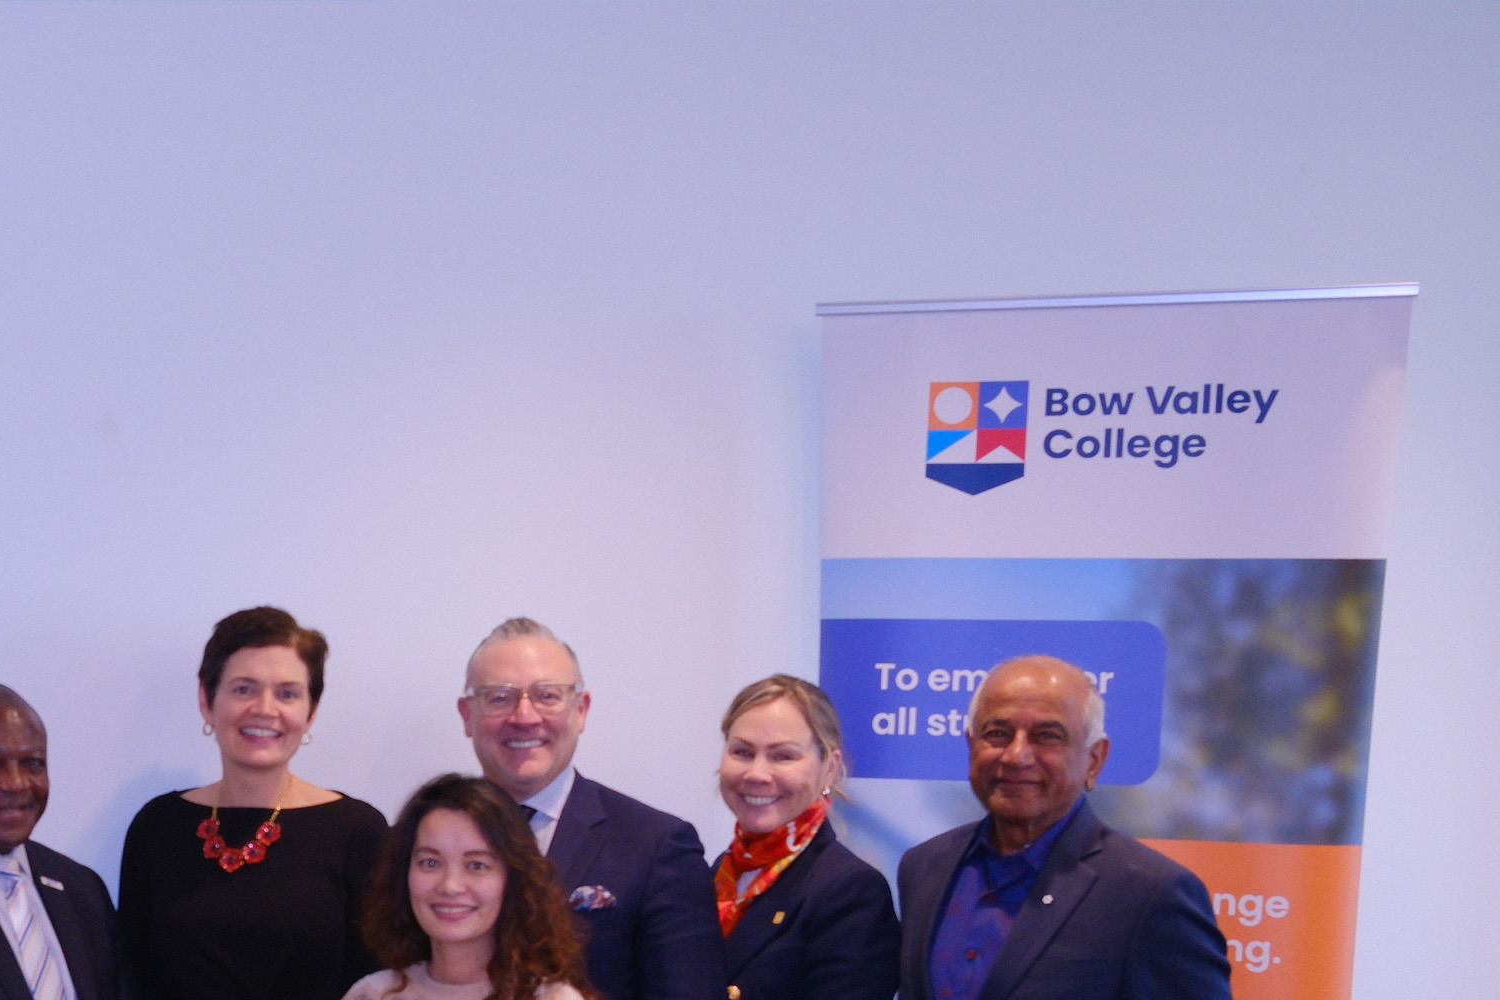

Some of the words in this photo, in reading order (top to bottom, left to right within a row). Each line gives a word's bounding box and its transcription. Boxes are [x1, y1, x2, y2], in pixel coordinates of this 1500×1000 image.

[1045, 388, 1134, 416] Bow
[1146, 383, 1279, 424] Valley
[1043, 428, 1207, 469] College
[874, 663, 919, 691] To
[871, 706, 917, 736] all
[1213, 893, 1290, 928] nge
